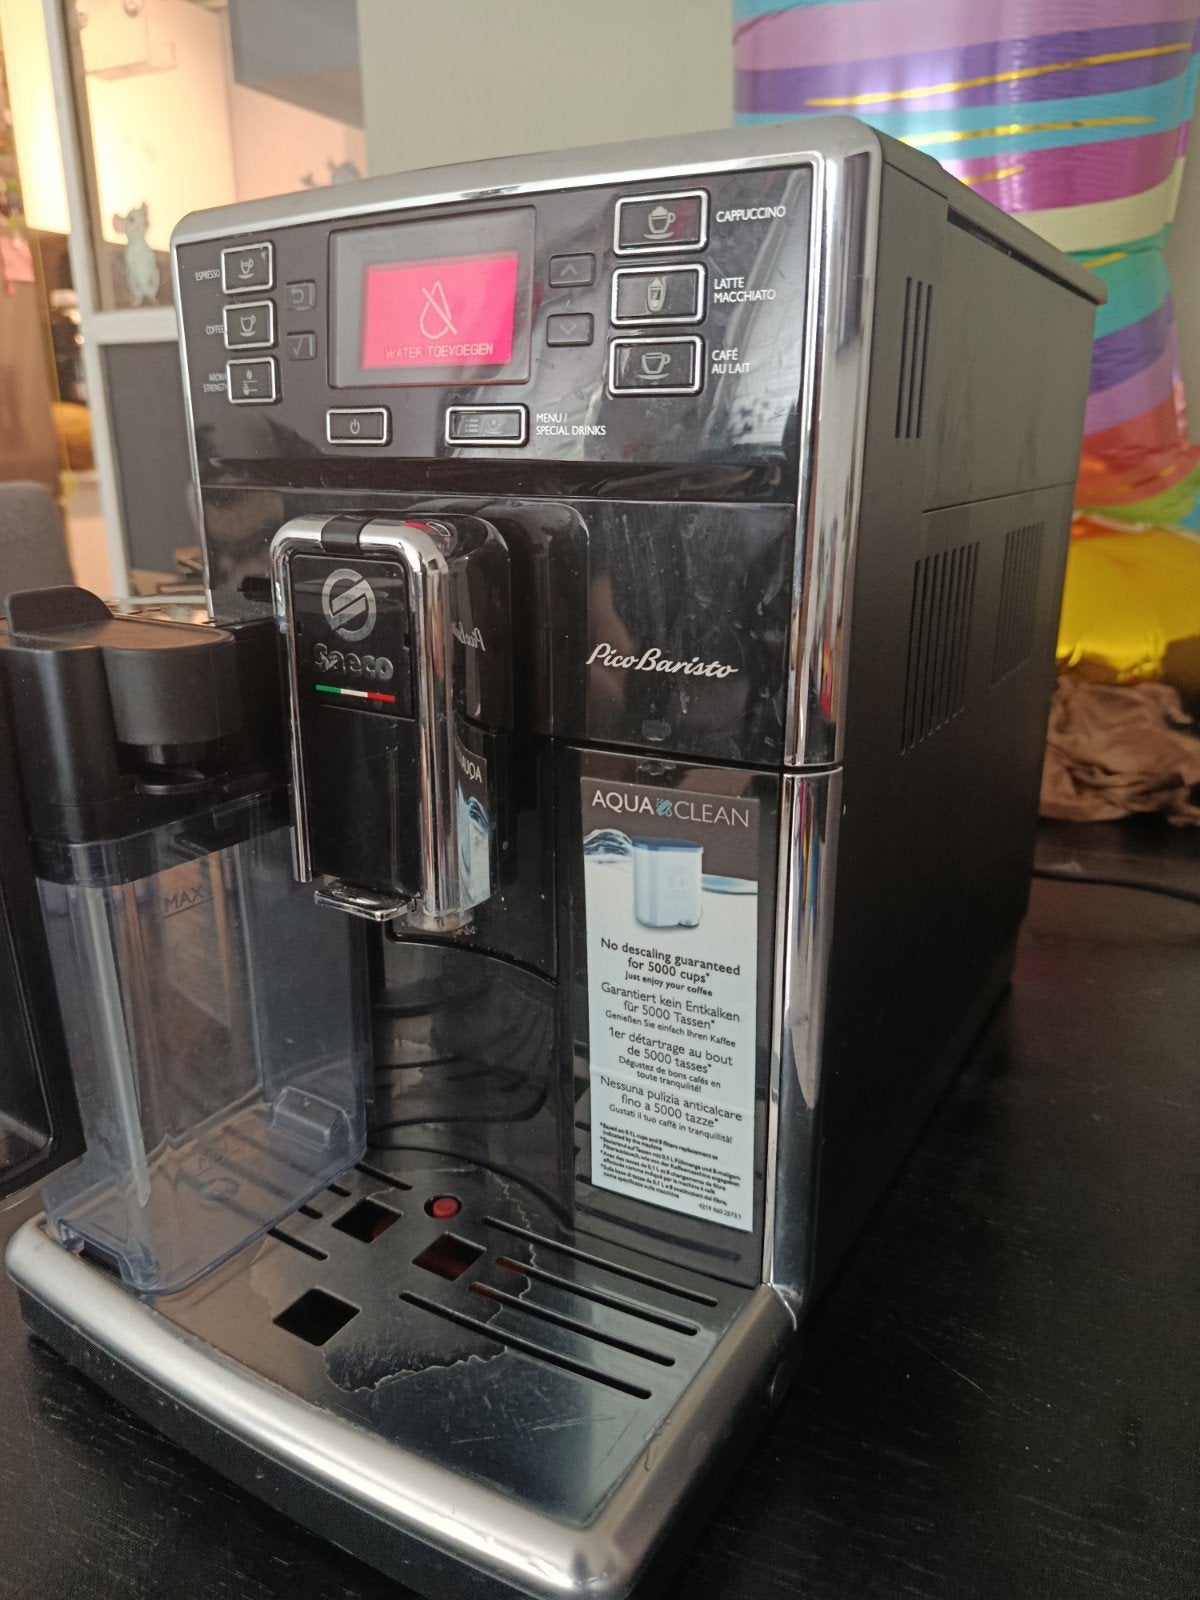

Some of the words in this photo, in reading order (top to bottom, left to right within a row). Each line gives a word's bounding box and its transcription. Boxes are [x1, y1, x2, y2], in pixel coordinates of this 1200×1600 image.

[716, 206, 786, 222] CAPPUCCINO
[195, 269, 220, 281] ESPRESSO
[714, 278, 744, 290] LATTE
[714, 290, 776, 303] MACCHIATO
[385, 346, 422, 359] WATER
[427, 343, 494, 357] TOEVOEGEN
[712, 348, 738, 361] CAFÉ
[712, 363, 727, 374] AU
[728, 362, 750, 373] LAIT
[536, 413, 562, 422] MENU
[536, 425, 569, 436] SPECIAL
[572, 425, 606, 436] DRINKS
[592, 790, 654, 815] AQUA
[674, 801, 749, 827] CLEAN
[163, 885, 203, 913] MAX
[601, 938, 618, 950] No
[622, 943, 671, 964] descaling
[674, 956, 740, 975] guaranteed
[628, 957, 644, 969] for
[648, 962, 676, 976] 5000
[625, 971, 640, 981] Just
[642, 977, 663, 987] enjoy
[666, 982, 684, 990] your
[687, 986, 712, 996] coffee
[602, 982, 656, 1004] Garantiert
[660, 995, 681, 1009] kein
[686, 1000, 740, 1022] Entkalken
[624, 1000, 638, 1012] für
[642, 1005, 670, 1020] 5000
[606, 1010, 641, 1025] Genießen
[644, 1019, 655, 1028] Sie
[658, 1024, 684, 1035] einfach
[687, 1030, 707, 1040] Ihren
[710, 1035, 735, 1047] Kaffee
[609, 1027, 625, 1038] 1er
[629, 1033, 685, 1055] détartrage
[689, 1049, 701, 1058] au
[706, 1050, 732, 1066] bout
[628, 1046, 640, 1056] de
[644, 1048, 672, 1064] 5000
[619, 1056, 654, 1071] Dégustez
[656, 1066, 665, 1074] de
[668, 1069, 686, 1080] bons
[689, 1076, 708, 1085] cafés
[637, 1071, 657, 1081] toute
[601, 1076, 644, 1096] Nessuna
[648, 1090, 679, 1105] pulizia
[684, 1100, 742, 1121] anticalcare
[622, 1094, 641, 1107] fino
[654, 1103, 682, 1118] 5000
[609, 1104, 635, 1117] Gustati
[644, 1114, 656, 1123] tuo
[659, 1120, 676, 1129] caffè
[679, 1123, 686, 1131] in
[679, 1146, 711, 1158] replacement
